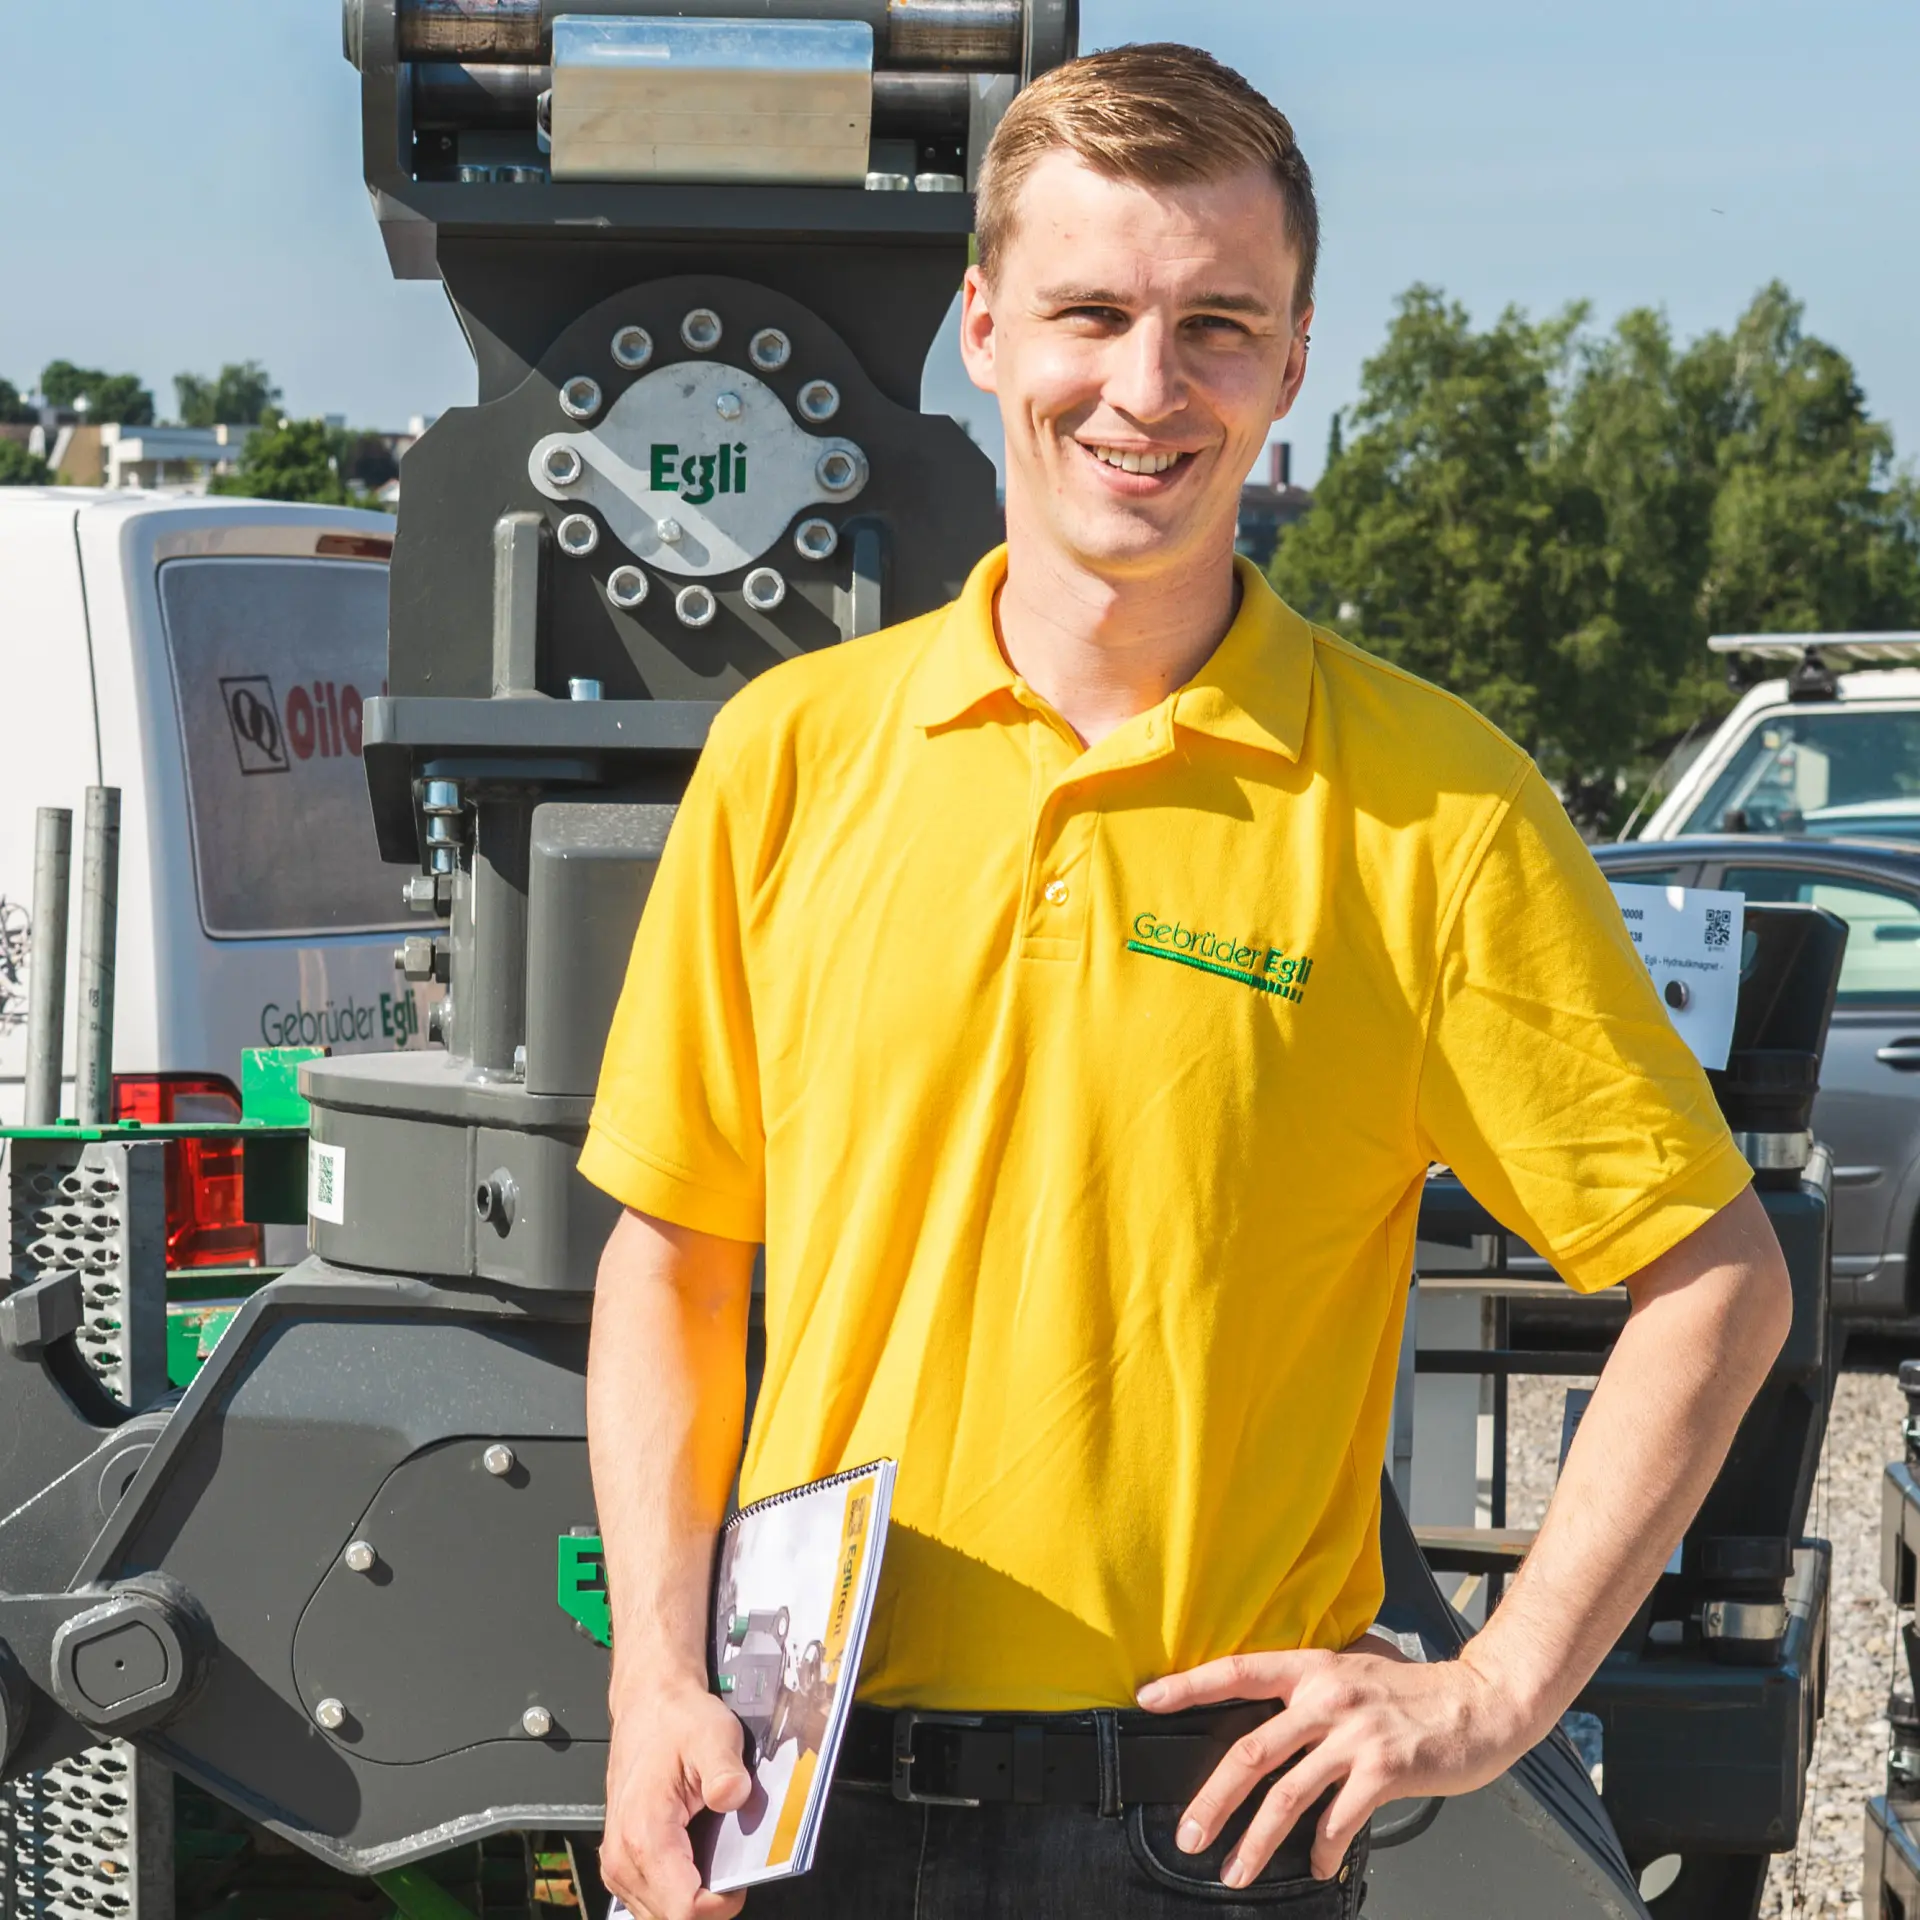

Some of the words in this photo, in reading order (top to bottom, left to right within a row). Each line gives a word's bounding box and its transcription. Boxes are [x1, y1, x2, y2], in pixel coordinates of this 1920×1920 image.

[650, 442, 748, 505] Egli
[1133, 912, 1261, 969] Gebrüder
[1263, 947, 1314, 984] Egli
[261, 995, 375, 1047] Gebrüder
[380, 989, 418, 1047] Egli
